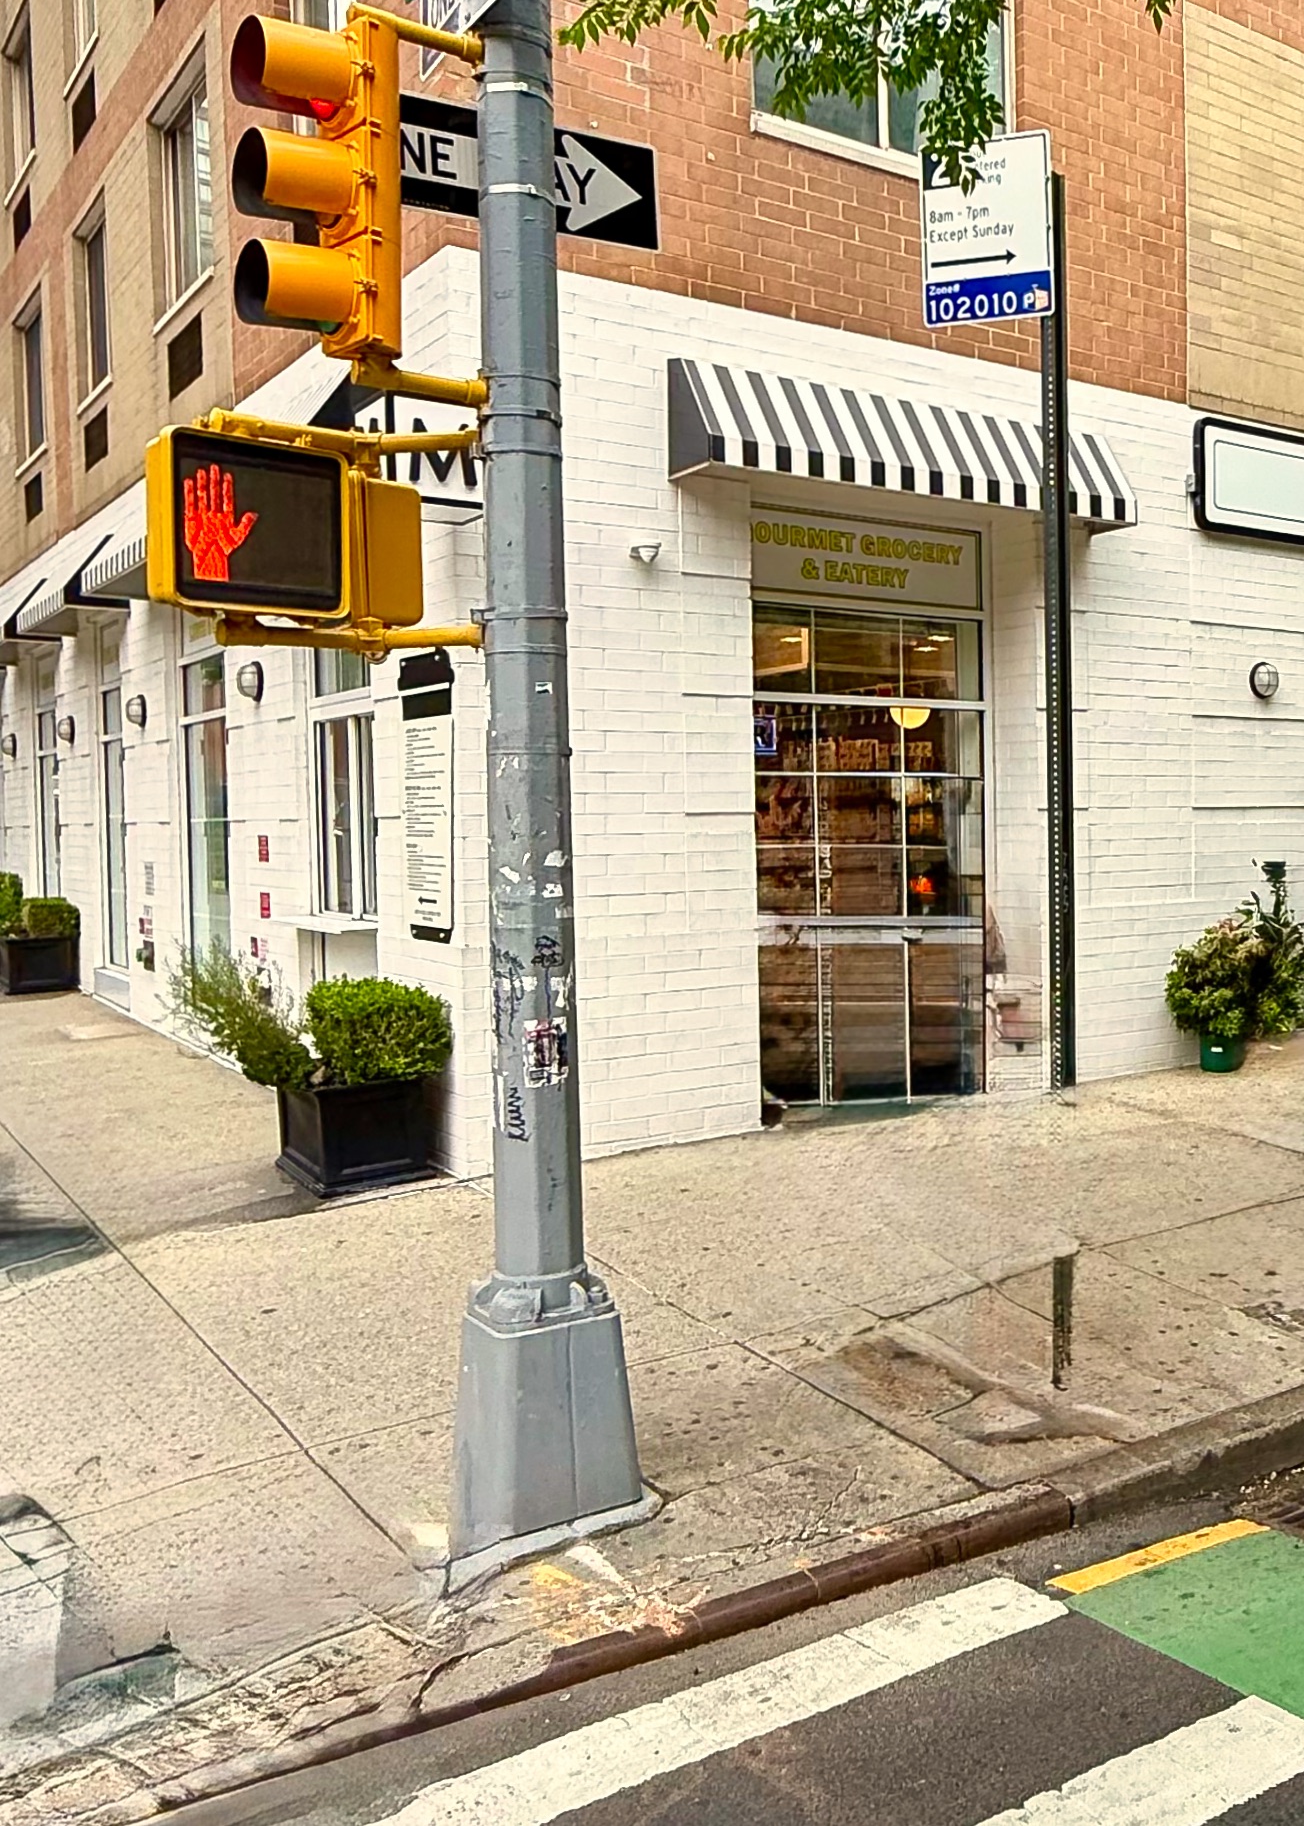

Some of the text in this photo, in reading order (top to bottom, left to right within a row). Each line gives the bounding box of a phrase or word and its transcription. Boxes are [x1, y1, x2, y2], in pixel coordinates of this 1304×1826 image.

[400, 128, 597, 216] NE AY
[929, 210, 954, 224] 8am
[965, 205, 990, 221] 7pm
[929, 221, 1015, 244] Except Sunday
[929, 291, 1018, 322] 102010
[751, 520, 963, 566] OURMET GROCERY
[801, 557, 910, 589] & EATERY
